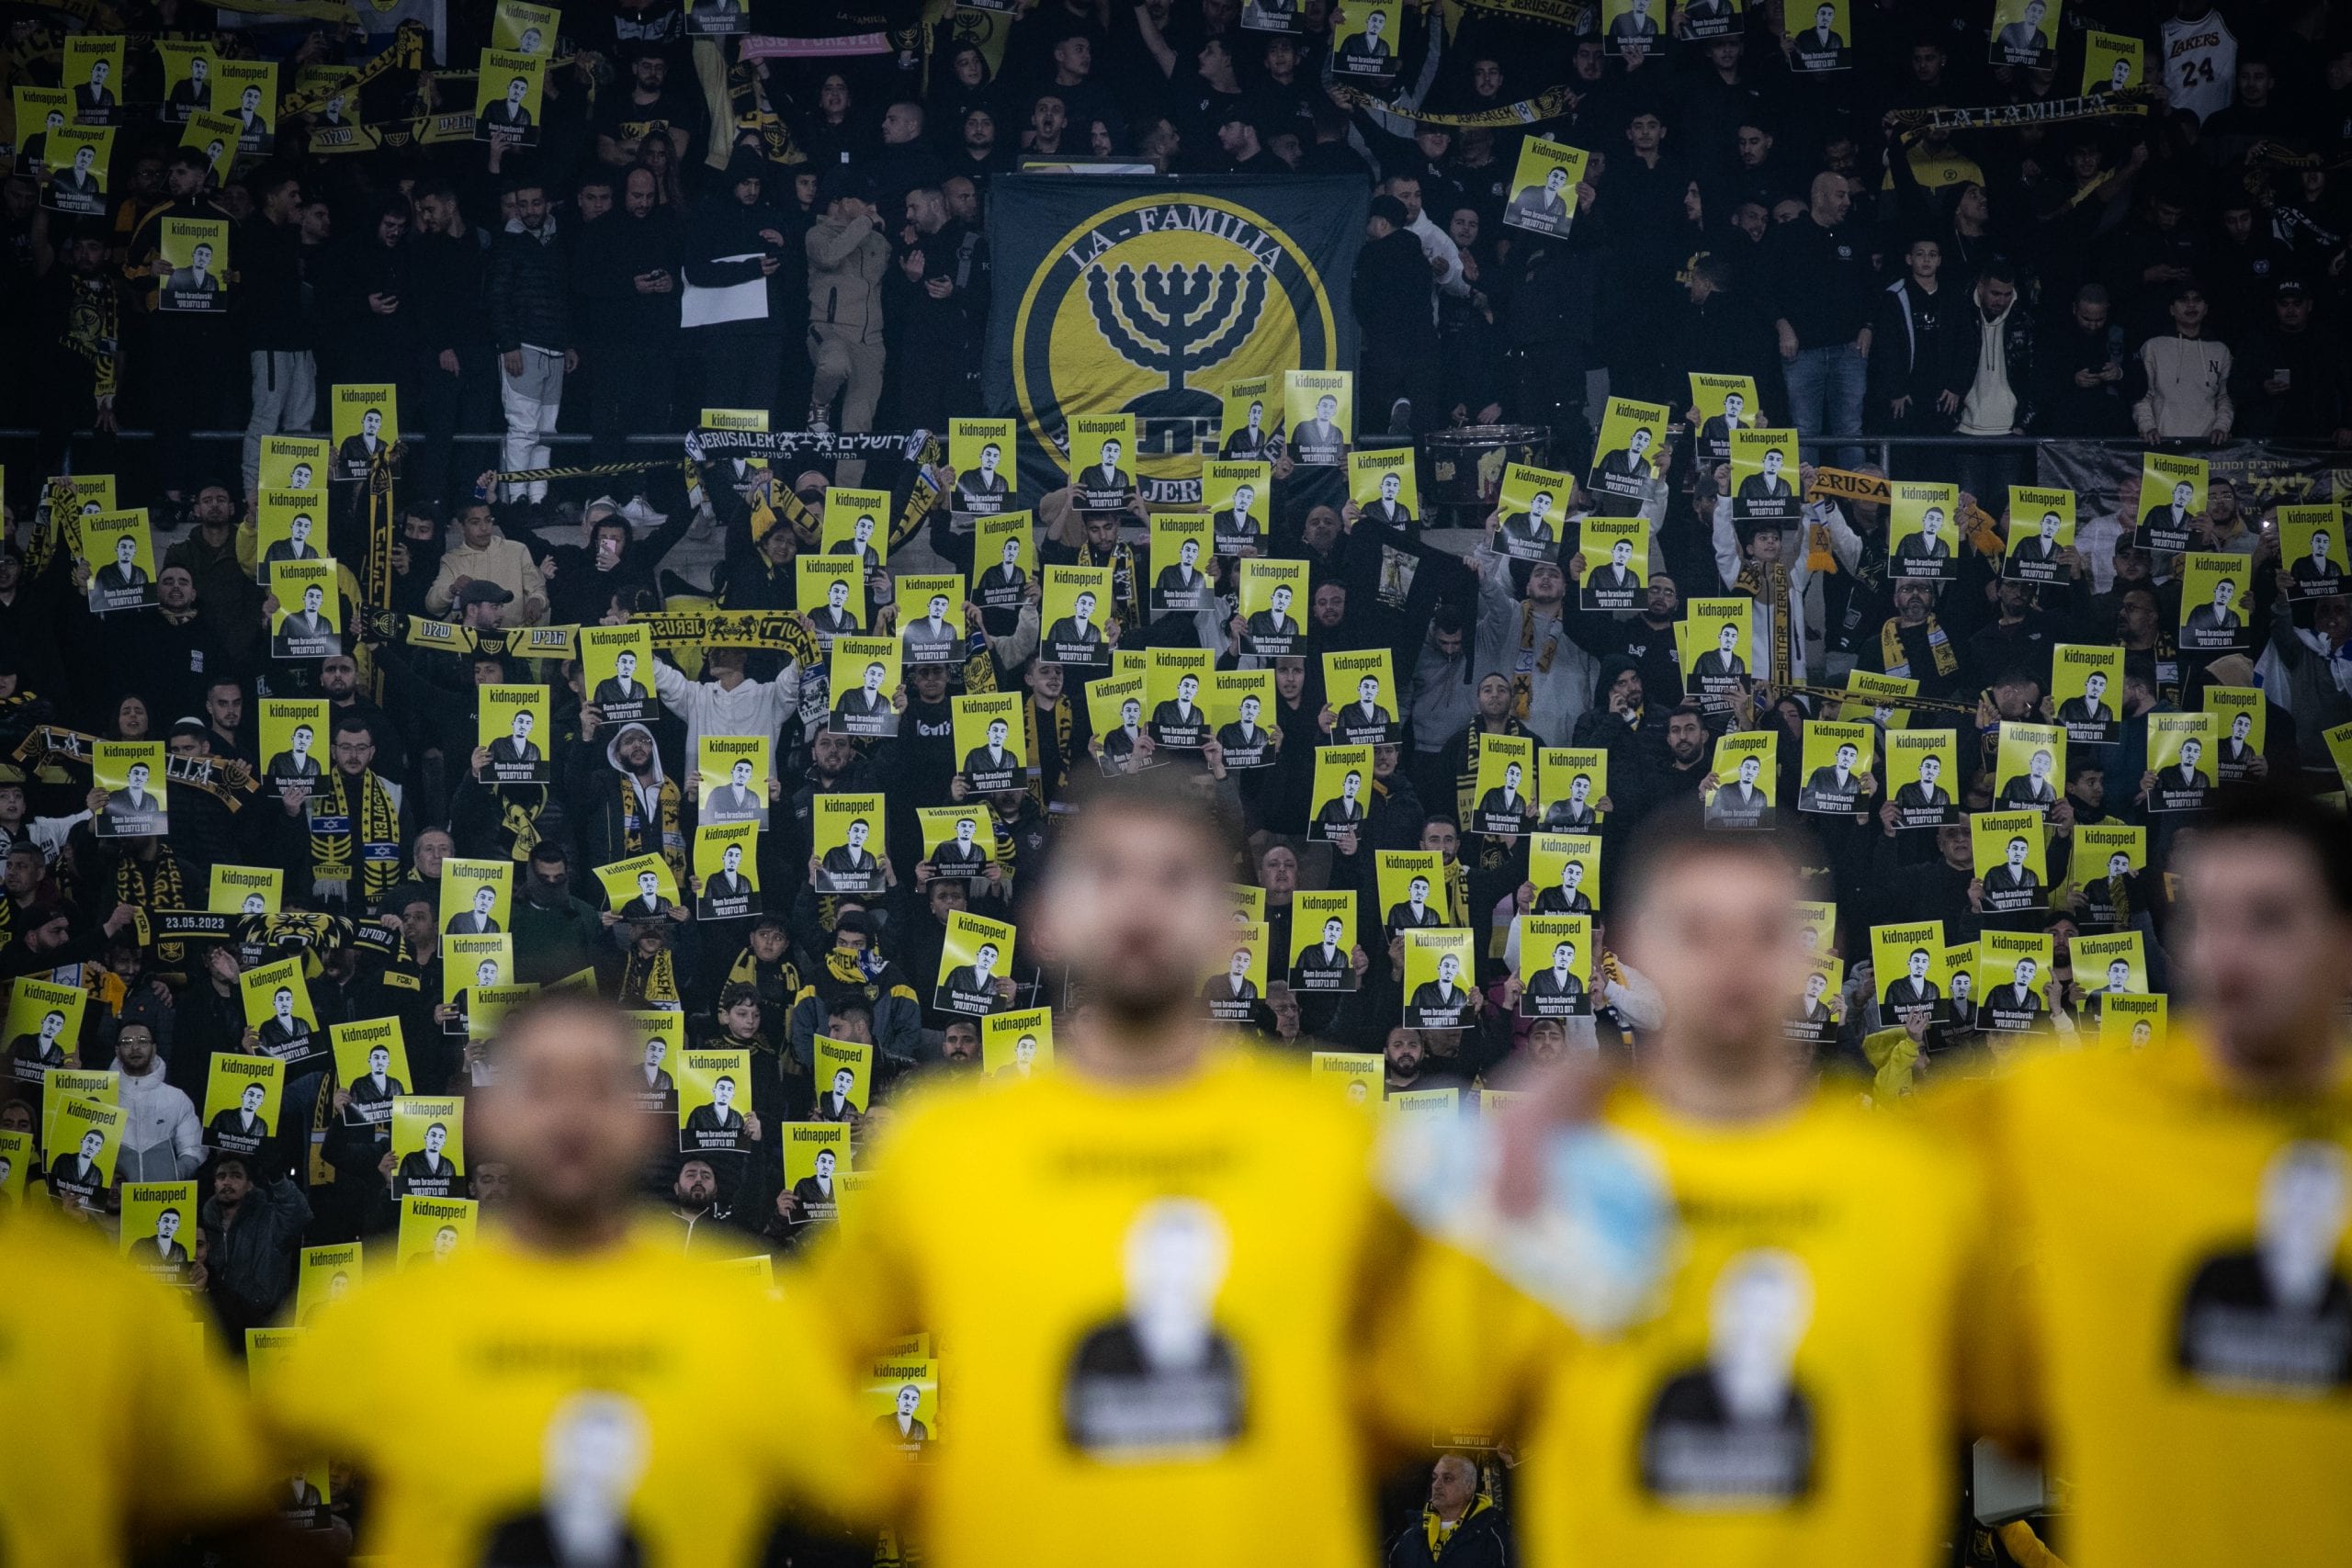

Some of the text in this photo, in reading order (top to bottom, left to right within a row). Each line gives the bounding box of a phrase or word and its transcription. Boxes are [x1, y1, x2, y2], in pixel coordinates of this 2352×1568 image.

[506, 5, 551, 24] kidnapped
[74, 41, 116, 55] kidnapped
[2096, 36, 2135, 54] kidnapped
[2169, 32, 2221, 59] LAKERS
[491, 54, 536, 72] kidnapped
[222, 65, 267, 81] kidnapped
[2181, 57, 2214, 87] 24
[23, 91, 67, 106] kidnapped
[197, 115, 235, 134] kidnapped
[1933, 107, 1974, 129] LA
[58, 128, 105, 141] kidnapped
[1532, 142, 1578, 164] kidnapped
[172, 222, 218, 238] kidnapped
[1064, 229, 1117, 272] LA
[1135, 205, 1284, 273] FAMILIA
[1232, 380, 1266, 397] kidnapped
[1296, 376, 1342, 390] kidnapped
[1700, 377, 1746, 389] kidnapped
[342, 389, 386, 404] kidnapped
[711, 413, 758, 429] kidnapped
[1616, 403, 1660, 423] kidnapped
[959, 423, 1006, 438] kidnapped
[1079, 419, 1125, 434] kidnapped
[699, 432, 775, 449] JERUSALEM
[838, 434, 910, 450] ירושלים
[1740, 433, 1788, 445] kidnapped
[271, 441, 319, 458] kidnapped
[1358, 453, 1404, 468] kidnapped
[2154, 458, 2199, 476] kidnapped
[1213, 466, 1260, 479] kidnapped
[1515, 468, 1563, 488] kidnapped
[269, 493, 317, 509] kidnapped
[836, 493, 881, 510] kidnapped
[1902, 487, 1950, 502] kidnapped
[2019, 491, 2065, 507] kidnapped
[90, 514, 139, 532] kidnapped
[985, 516, 1023, 535] kidnapped
[2288, 510, 2333, 525] kidnapped
[1160, 519, 1204, 534] kidnapped
[1591, 522, 1639, 535] kidnapped
[280, 566, 327, 580] kidnapped
[807, 560, 854, 575] kidnapped
[1251, 564, 1299, 580] kidnapped
[2196, 558, 2242, 573] kidnapped
[906, 579, 955, 591] kidnapped
[1055, 570, 1102, 587] kidnapped
[1698, 604, 1743, 618] kidnapped
[422, 622, 566, 646] הגביע שלנו
[591, 629, 639, 646] kidnapped
[843, 641, 892, 657] kidnapped
[1777, 626, 1787, 671] BEITAR
[1157, 653, 1204, 669] kidnapped
[1333, 655, 1382, 671] kidnapped
[2064, 649, 2114, 667] kidnapped
[1096, 677, 1142, 697] kidnapped
[1216, 675, 1264, 691] kidnapped
[1859, 676, 1907, 695] kidnapped
[491, 690, 539, 705] kidnapped
[2214, 691, 2256, 707] kidnapped
[270, 705, 319, 719] kidnapped
[963, 698, 1012, 714] kidnapped
[1815, 725, 1864, 739] kidnapped
[2158, 717, 2208, 733] kidnapped
[46, 728, 80, 757] LA
[1724, 736, 1767, 750] kidnapped
[1896, 735, 1946, 750] kidnapped
[2010, 728, 2058, 745] kidnapped
[104, 746, 154, 759] kidnapped
[710, 740, 758, 754] kidnapped
[1488, 739, 1525, 757] kidnapped
[1325, 750, 1365, 765] kidnapped
[1549, 753, 1597, 769] kidnapped
[825, 799, 874, 814] kidnapped
[1982, 816, 2032, 832] kidnapped
[705, 825, 750, 840] kidnapped
[2086, 830, 2135, 846] kidnapped
[1542, 839, 1590, 855] kidnapped
[605, 857, 654, 875] kidnapped
[1386, 855, 1433, 871] kidnapped
[221, 870, 272, 888] kidnapped
[453, 864, 503, 881] kidnapped
[1303, 897, 1347, 911] kidnapped
[166, 917, 225, 930] 23.05.2023
[958, 917, 1006, 940] kidnapped
[1531, 920, 1580, 936] kidnapped
[1416, 933, 1463, 948] kidnapped
[1883, 927, 1933, 944] kidnapped
[454, 939, 502, 954] kidnapped
[1993, 936, 2042, 953] kidnapped
[2081, 937, 2132, 955] kidnapped
[249, 964, 293, 988] kidnapped
[24, 984, 76, 1005] kidnapped
[2112, 998, 2157, 1014] kidnapped
[993, 1013, 1041, 1032] kidnapped
[342, 1023, 390, 1043] kidnapped
[821, 1041, 862, 1063] kidnapped
[221, 1059, 274, 1077] kidnapped
[689, 1055, 740, 1071] kidnapped
[1323, 1058, 1374, 1075] kidnapped
[56, 1075, 107, 1092] kidnapped
[67, 1101, 117, 1124] kidnapped
[403, 1102, 453, 1118] kidnapped
[793, 1128, 840, 1144] kidnapped
[133, 1187, 186, 1203] kidnapped
[413, 1201, 466, 1220] kidnapped
[310, 1248, 353, 1267] kidnapped
[873, 1362, 928, 1381] kidnapped
